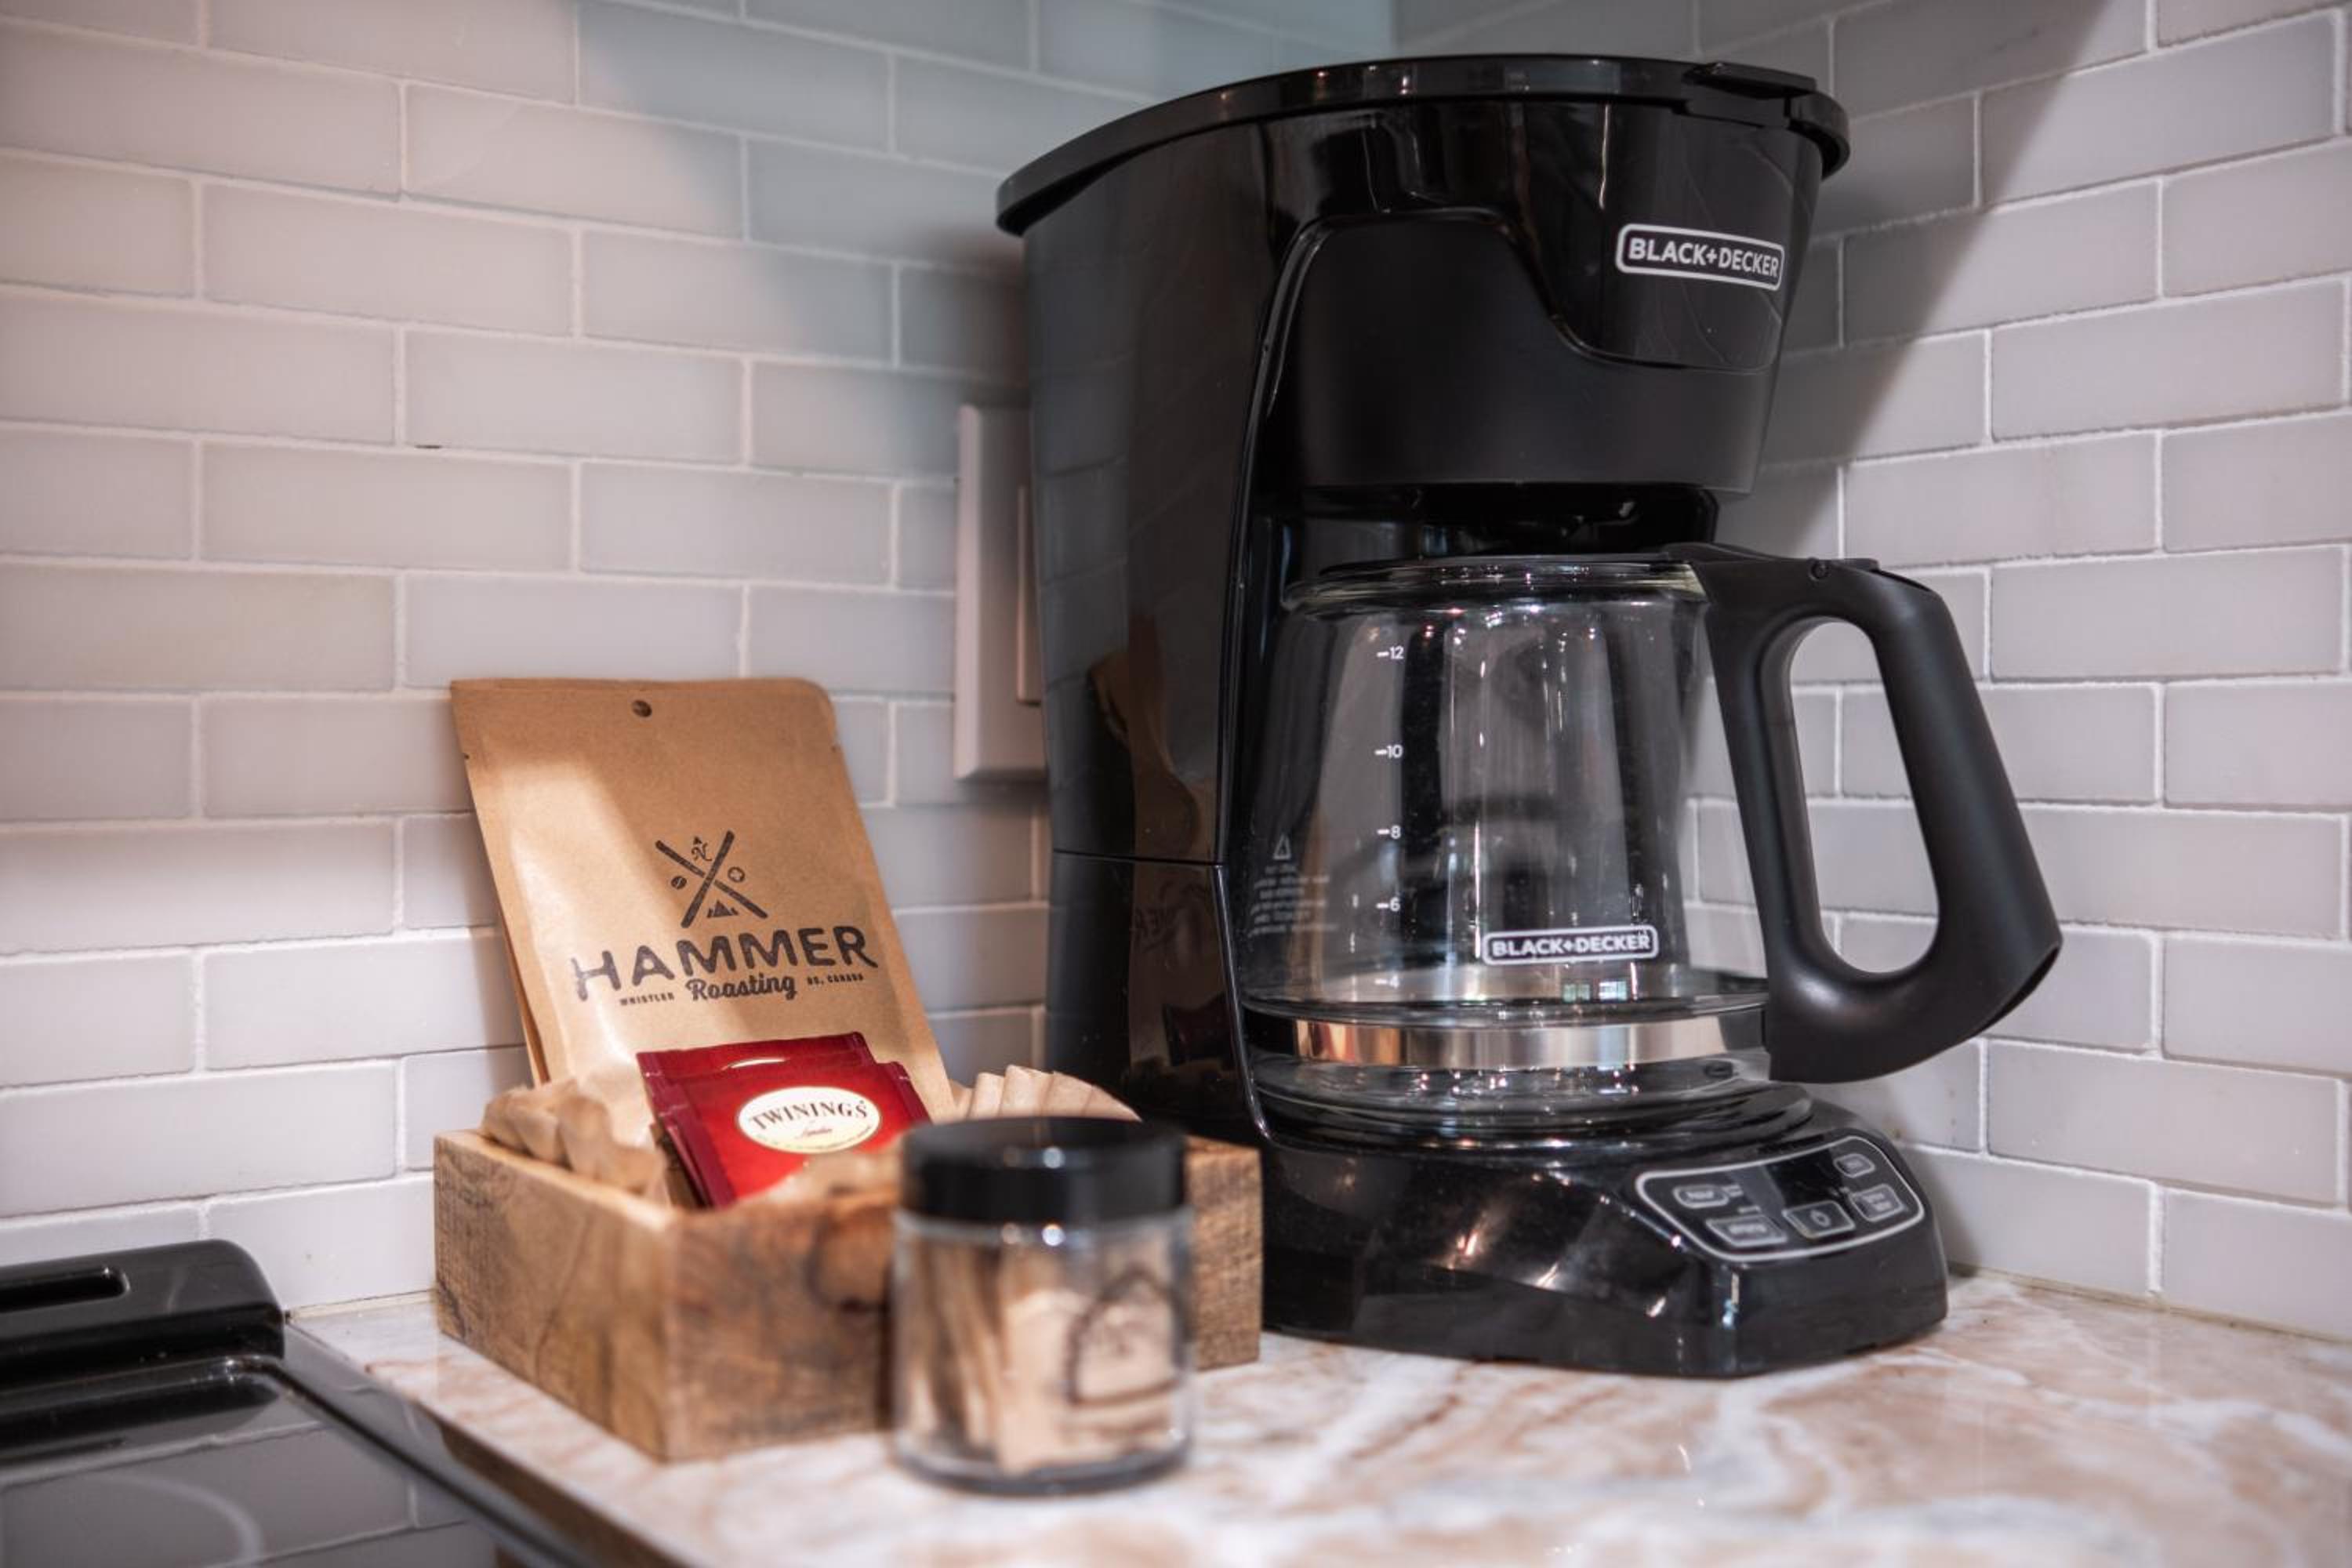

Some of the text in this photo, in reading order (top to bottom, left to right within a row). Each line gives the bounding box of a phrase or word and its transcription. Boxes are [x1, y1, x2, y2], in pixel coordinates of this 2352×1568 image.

[1628, 237, 1780, 278] BLACK+DECKER
[1390, 645, 1404, 659] 12
[1387, 744, 1403, 758] 10
[1391, 825, 1402, 840] 8
[1390, 896, 1401, 912] 6
[1491, 934, 1650, 957] BLACK+DECKER
[571, 925, 879, 1001] HAMMER
[685, 973, 797, 1001] Roasting
[750, 1102, 868, 1130] TWININGS
